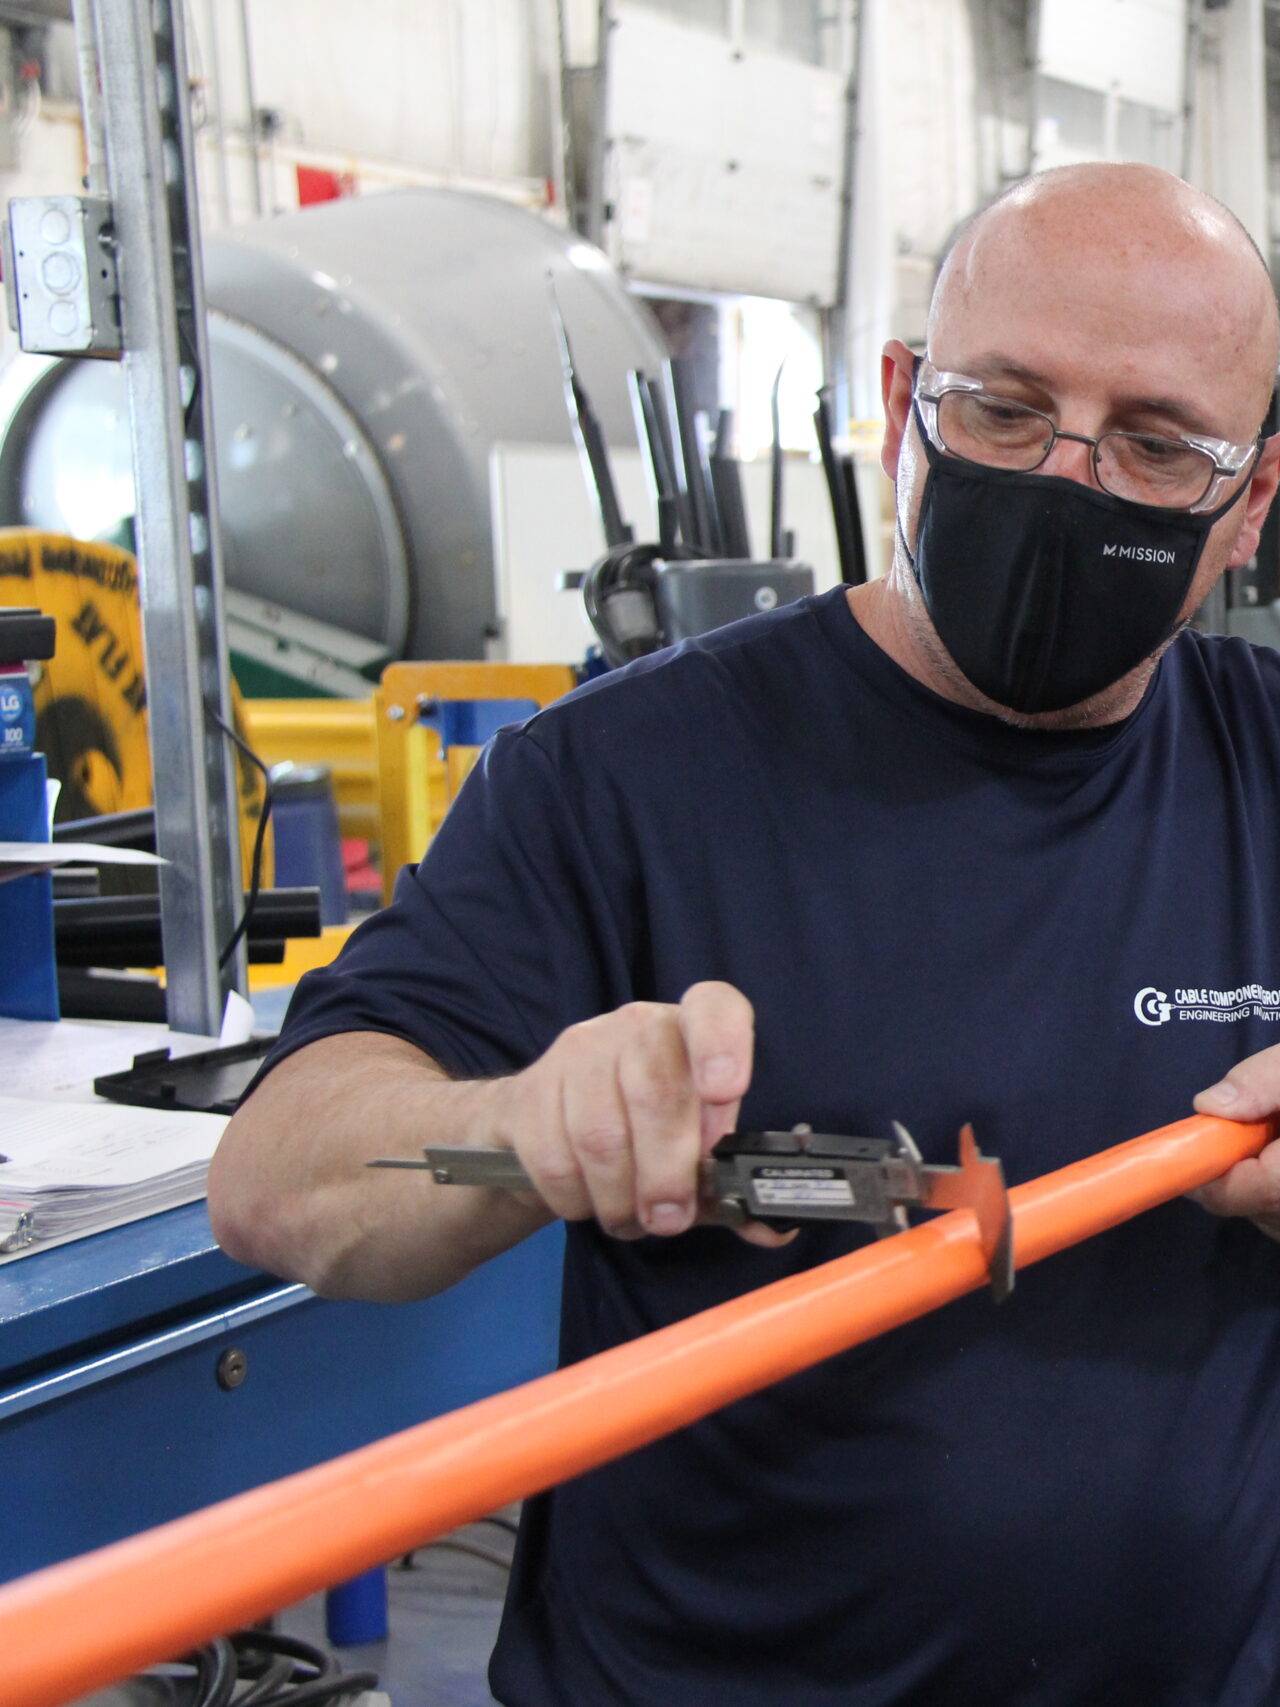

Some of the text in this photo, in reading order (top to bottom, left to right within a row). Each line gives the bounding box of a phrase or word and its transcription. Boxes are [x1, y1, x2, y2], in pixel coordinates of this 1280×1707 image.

[1119, 545, 1175, 564] MISSION
[1, 695, 20, 711] LG
[4, 727, 23, 742] 100
[1174, 988, 1208, 1004] CABLE
[1209, 983, 1263, 1007] COMPONEN
[1180, 1007, 1250, 1023] ENGINEERING
[761, 1167, 834, 1179] CALIBRATED
